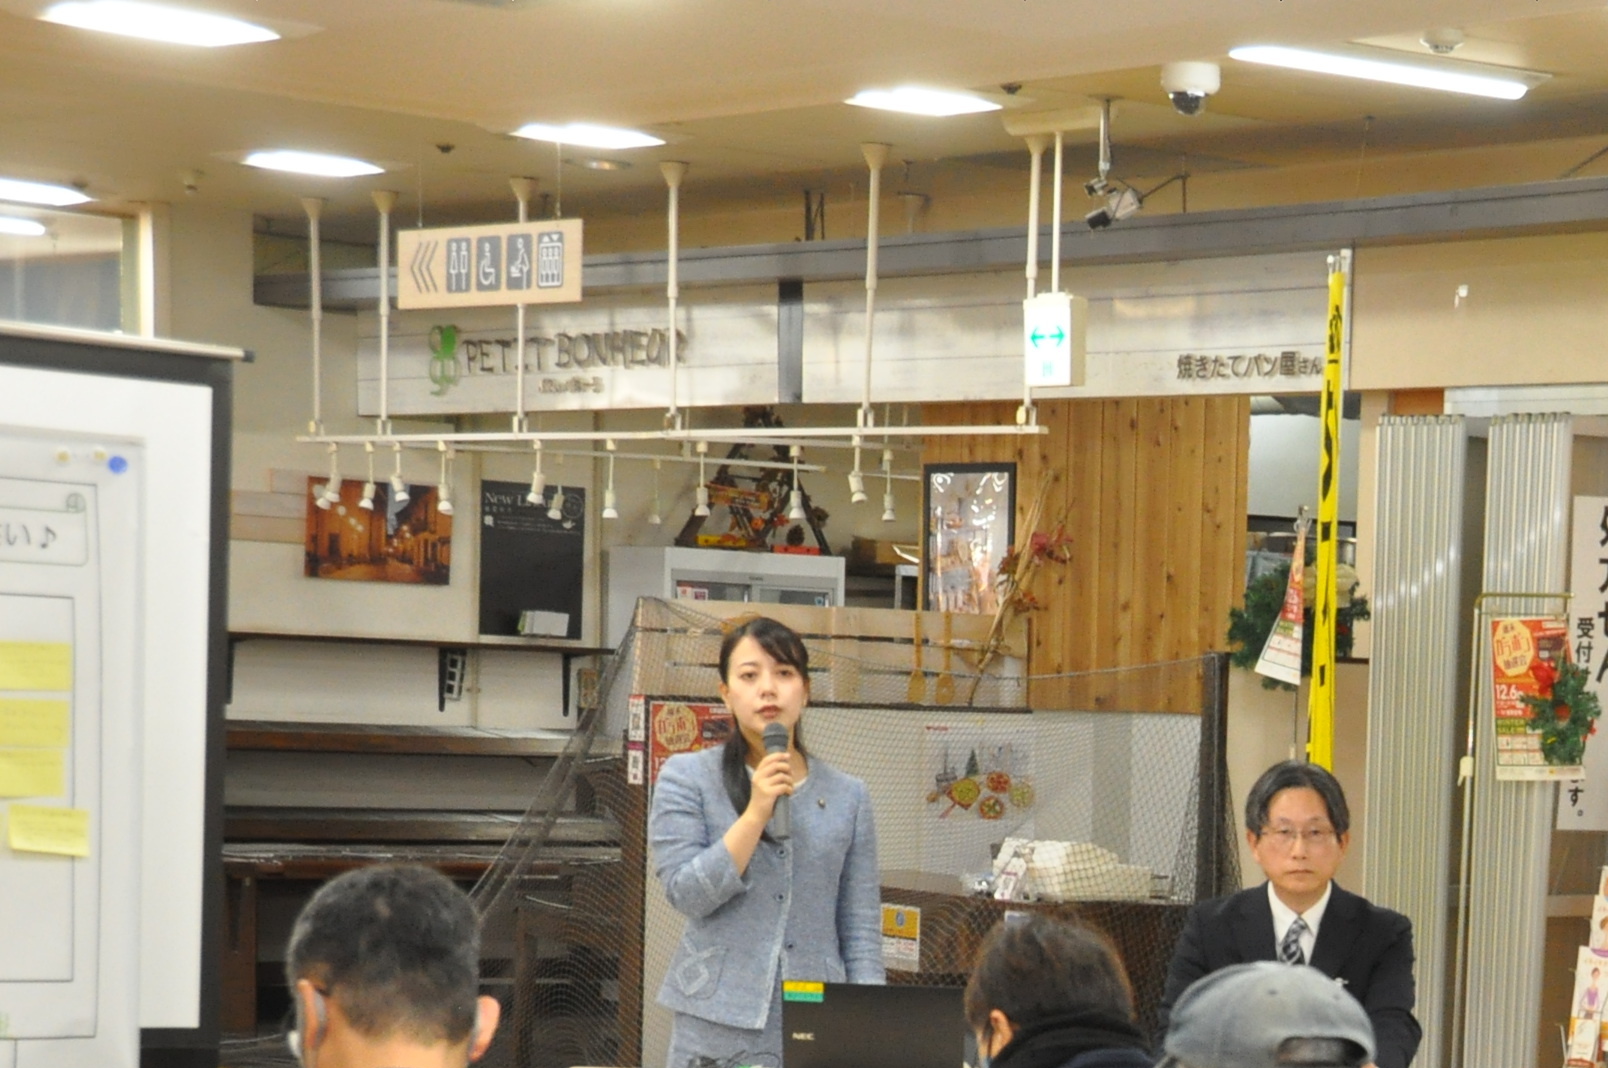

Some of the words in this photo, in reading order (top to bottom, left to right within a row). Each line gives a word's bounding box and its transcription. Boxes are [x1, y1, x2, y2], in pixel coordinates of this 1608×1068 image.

[463, 336, 554, 373] PETT
[1176, 351, 1323, 380] 焼きたてパン屋さん
[792, 1032, 815, 1040] NEC
